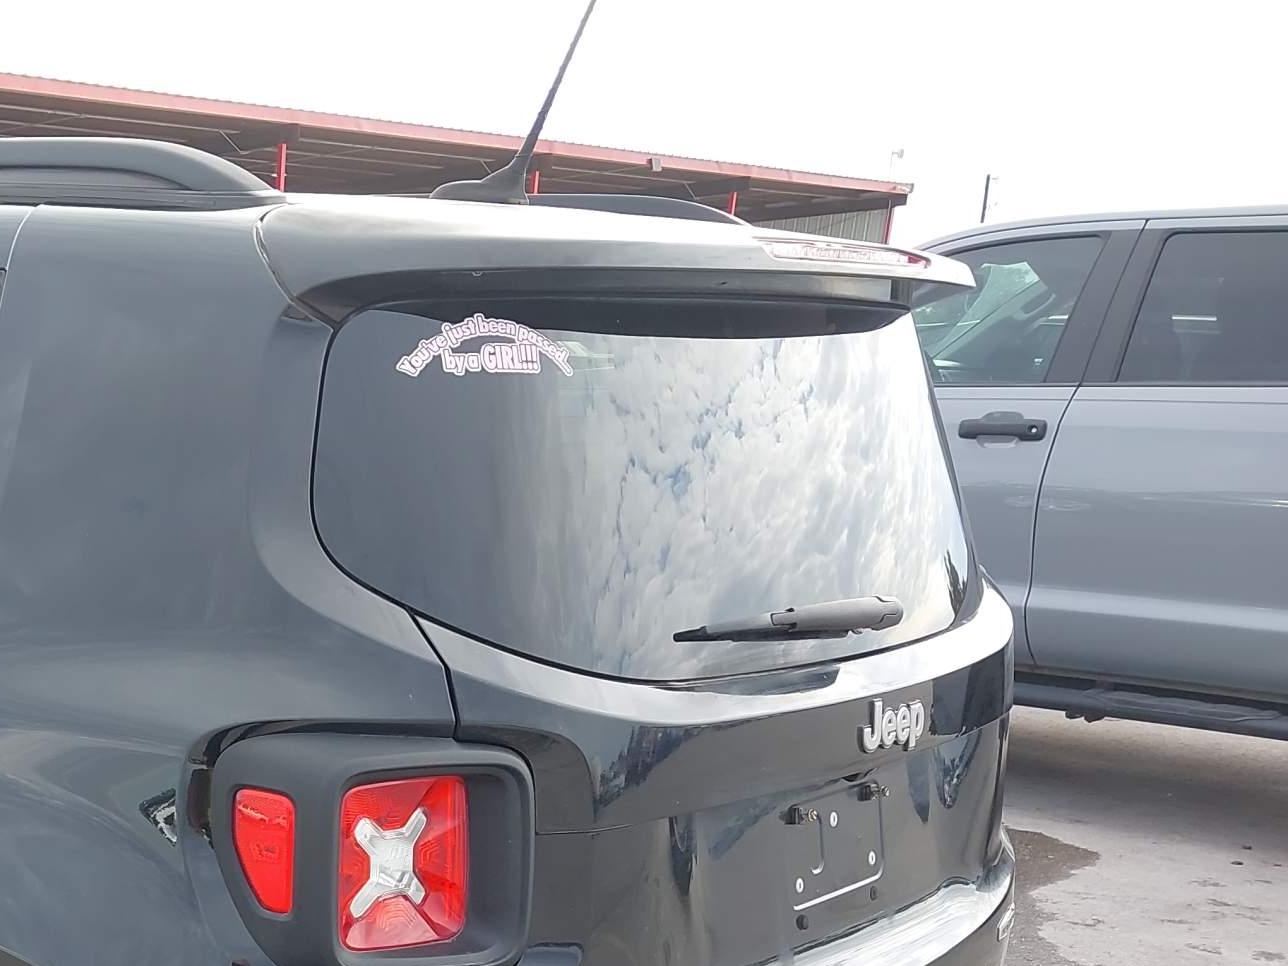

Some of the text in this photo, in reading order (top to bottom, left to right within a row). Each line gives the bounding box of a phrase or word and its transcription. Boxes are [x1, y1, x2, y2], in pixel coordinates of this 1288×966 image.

[398, 334, 448, 375] You've
[444, 321, 476, 346] just
[476, 315, 517, 337] been
[443, 343, 539, 374] by a GIRL!!!
[862, 697, 925, 753] Jeep
